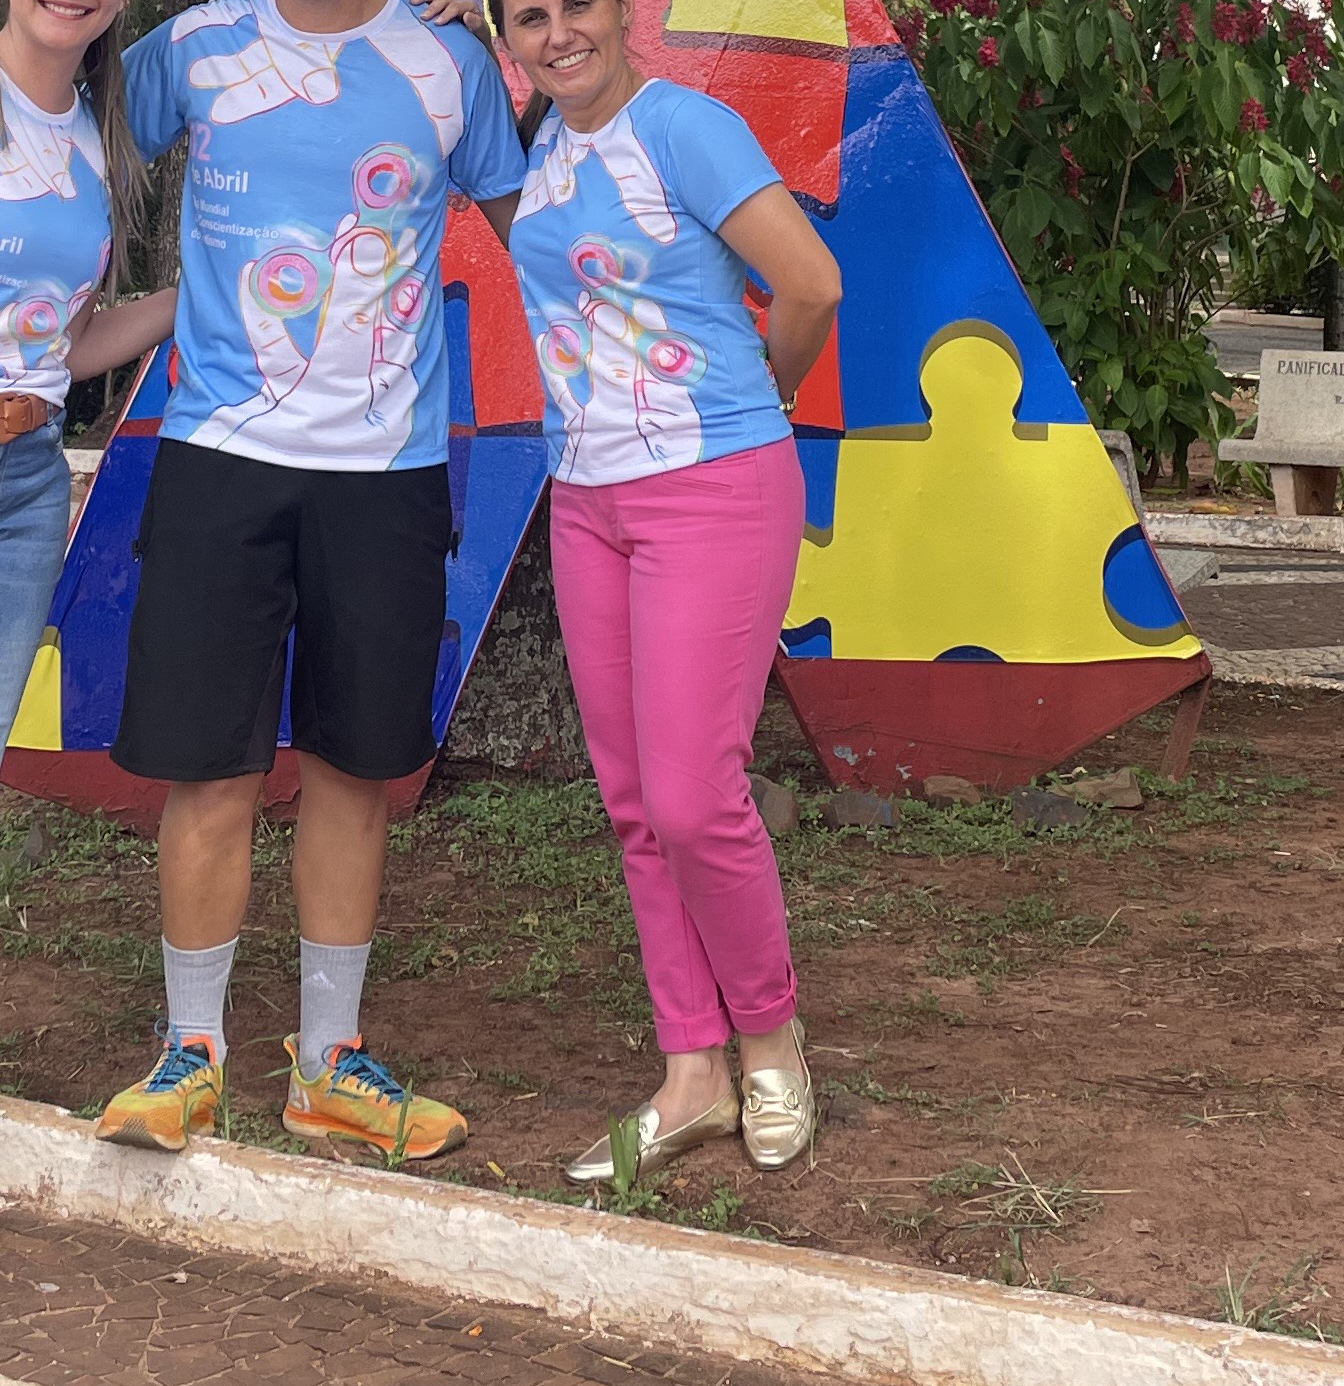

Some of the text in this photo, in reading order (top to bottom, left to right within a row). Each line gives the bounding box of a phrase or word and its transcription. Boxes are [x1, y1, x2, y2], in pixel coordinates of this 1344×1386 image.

[203, 166, 249, 193] Abril
[199, 198, 230, 217] Mundial
[203, 234, 227, 250] tismo
